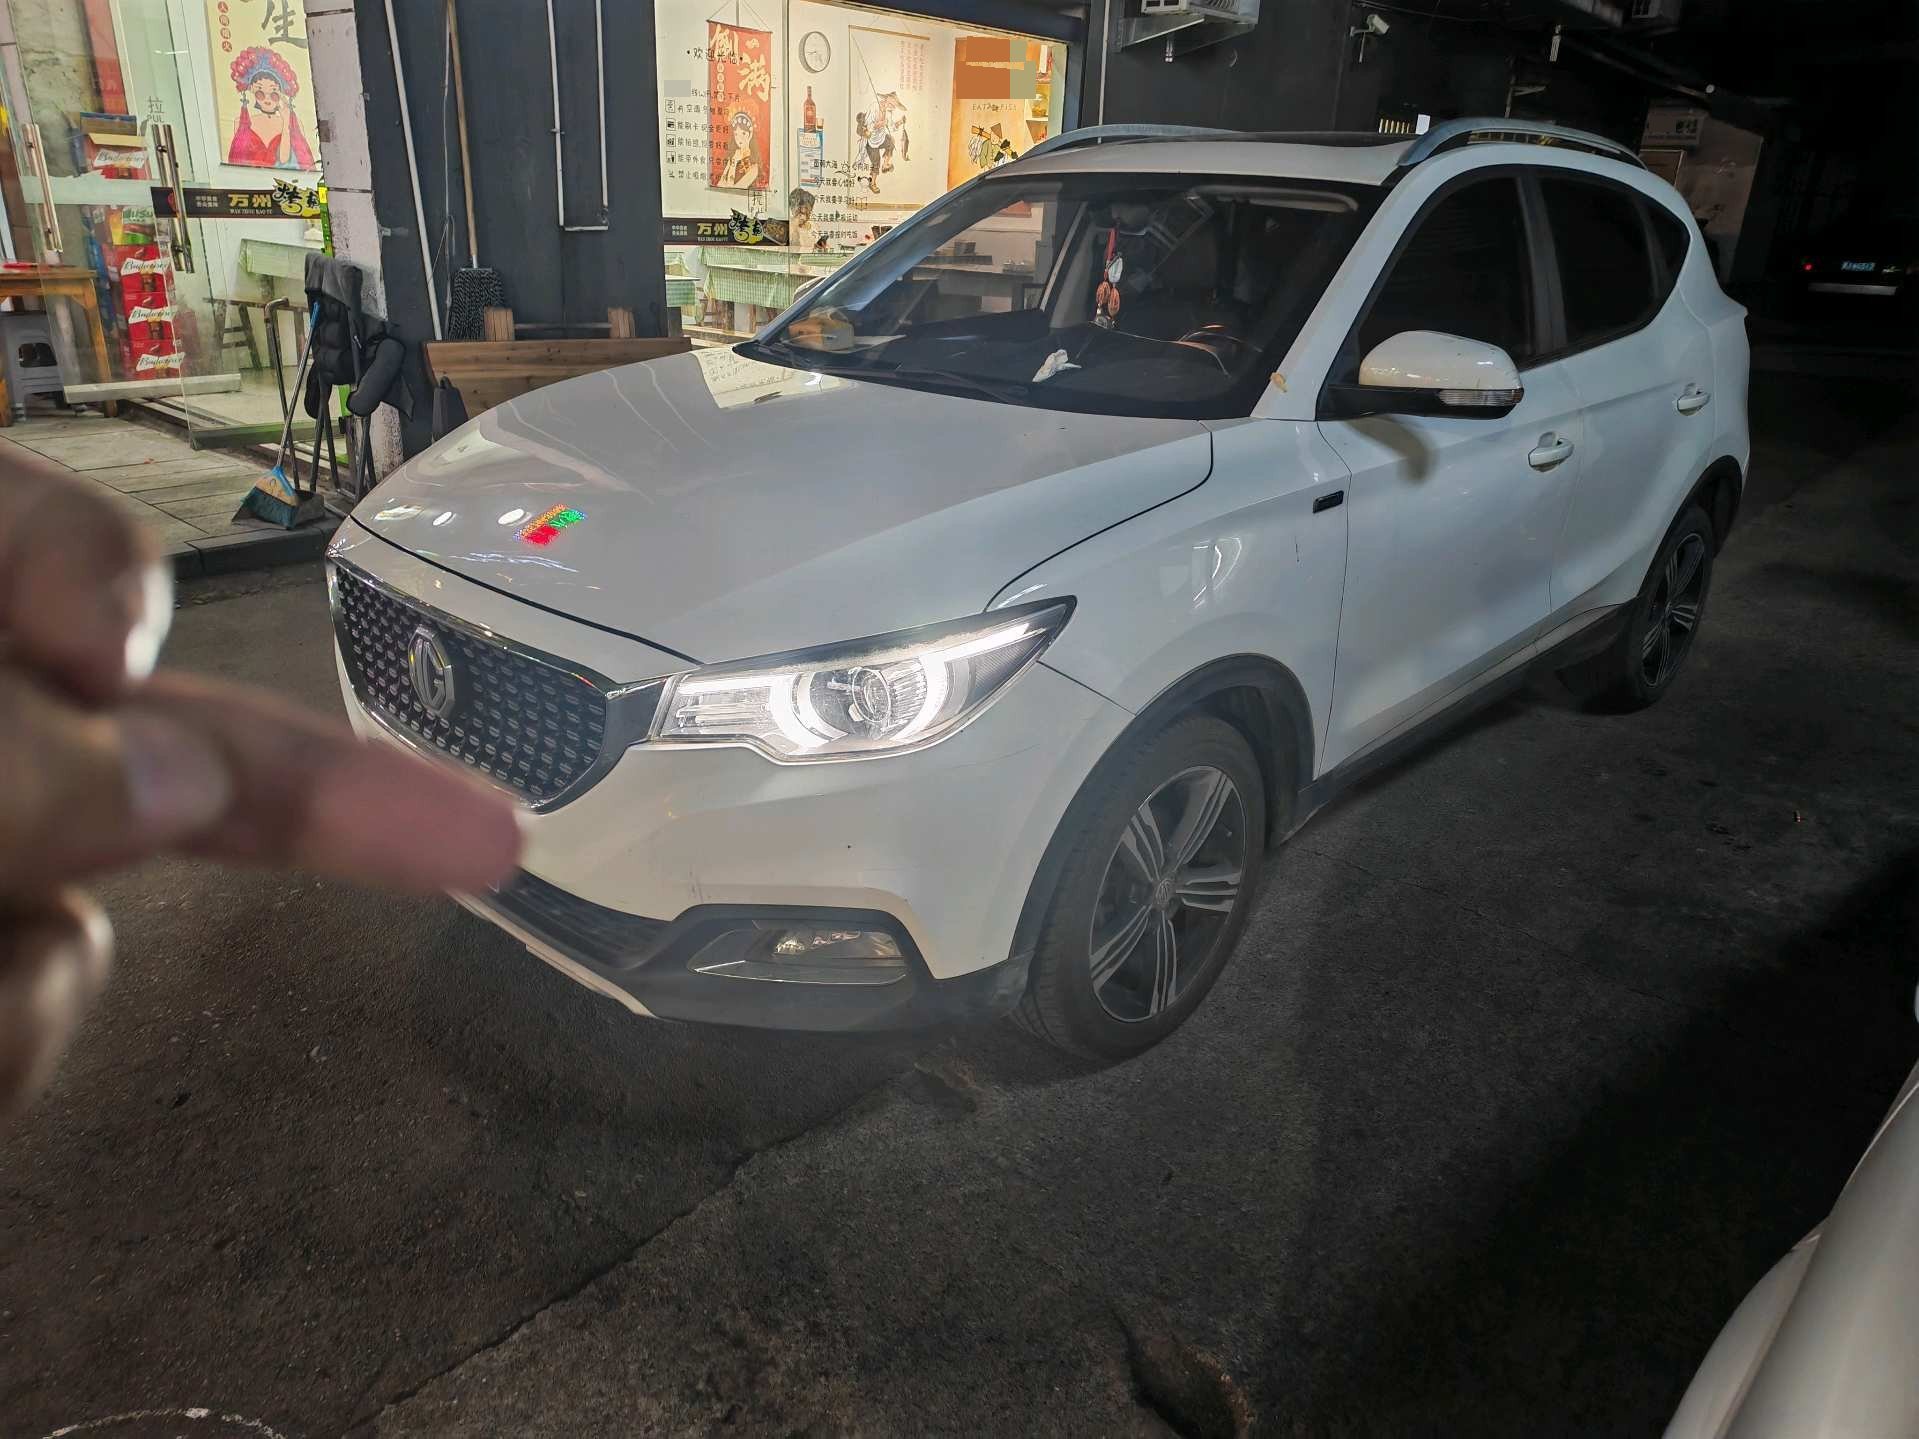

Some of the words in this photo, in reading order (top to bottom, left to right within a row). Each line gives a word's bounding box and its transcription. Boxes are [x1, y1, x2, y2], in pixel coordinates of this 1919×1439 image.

[148, 95, 164, 114] 拉
[227, 194, 272, 208] 万州
[697, 223, 728, 236] 万州
